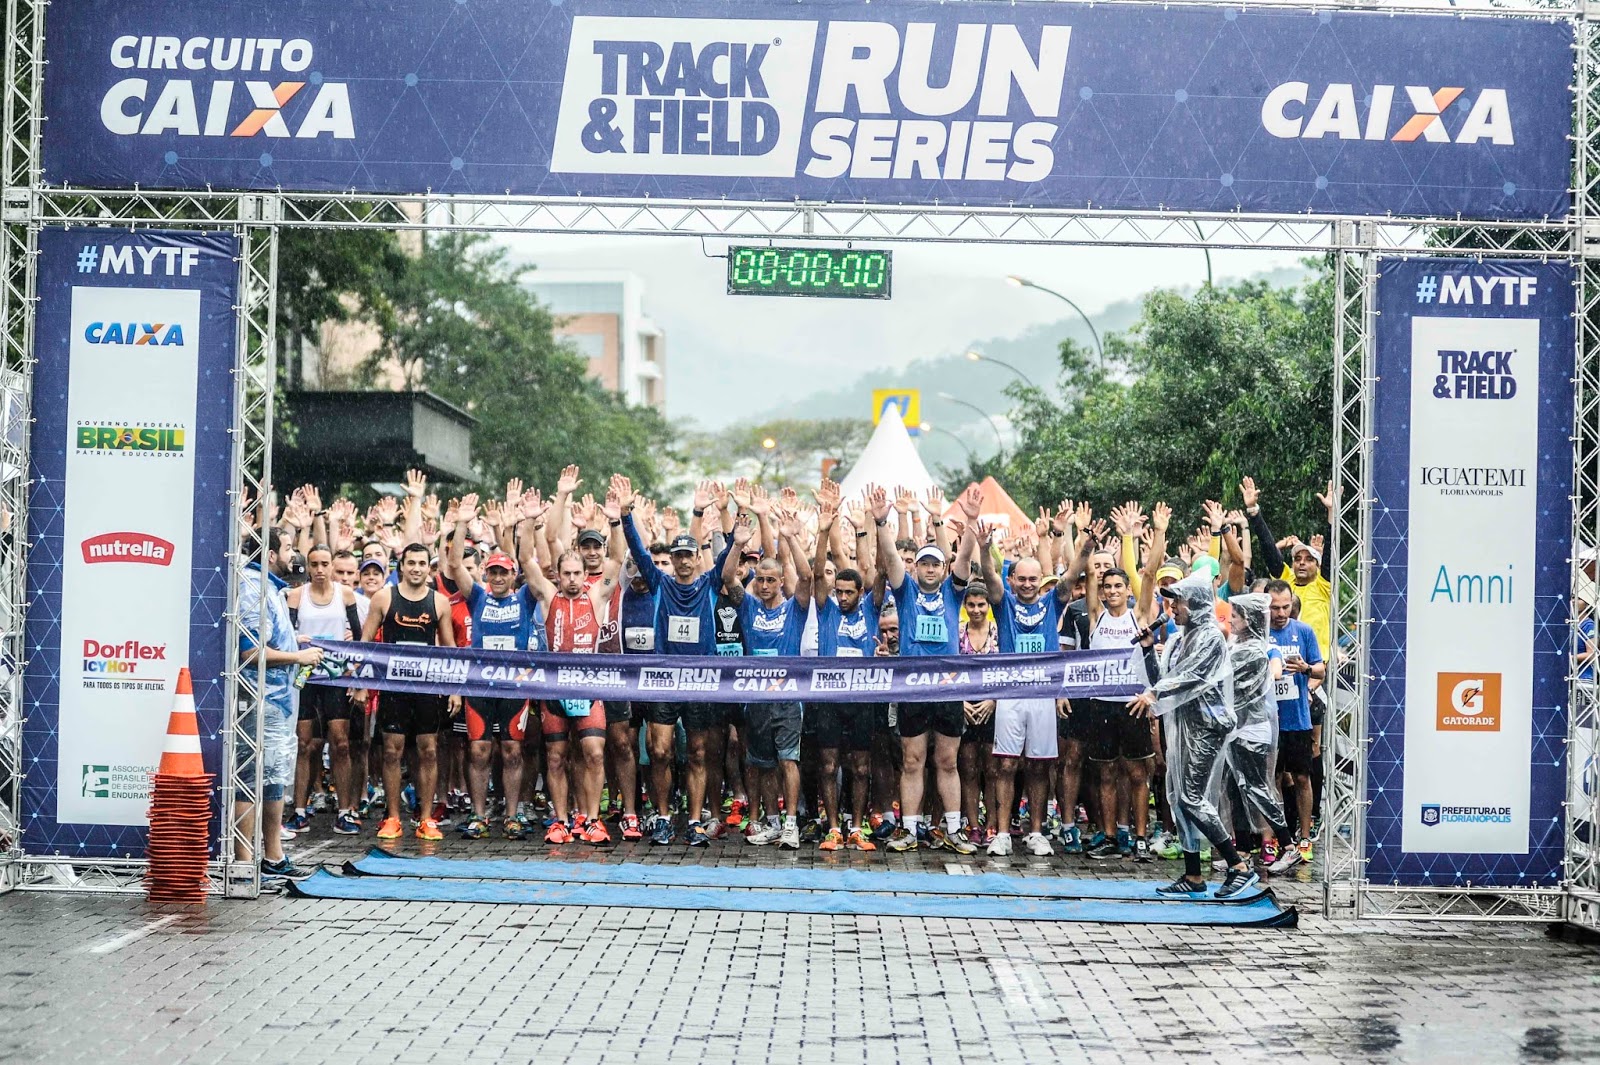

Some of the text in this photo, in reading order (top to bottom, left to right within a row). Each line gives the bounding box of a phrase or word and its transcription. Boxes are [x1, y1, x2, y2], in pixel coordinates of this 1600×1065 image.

[110, 35, 313, 71] CIRCUITO
[592, 40, 773, 98] TRACK
[818, 20, 1072, 118] RUN
[100, 78, 356, 138] CAIXA
[1261, 81, 1514, 145] CAIXA
[580, 98, 782, 156] & FIELD
[804, 118, 1057, 182] SERIES
[77, 245, 199, 276] #MYTF
[733, 250, 885, 288] 00:00:00
[1416, 275, 1537, 306] #MYTF
[85, 322, 184, 346] CAIXA
[1437, 350, 1513, 375] TRACK
[1432, 374, 1517, 400] & FIELD
[77, 427, 184, 451] BRASIL
[1420, 467, 1526, 487] IGUATEMI
[1440, 488, 1504, 496] FLORIANÓPOLIS
[89, 540, 165, 559] nutrella
[1430, 564, 1513, 604] Amni
[678, 624, 690, 636] 44
[921, 622, 942, 636] 1111
[635, 633, 647, 645] 35
[1020, 641, 1042, 652] 1188
[83, 640, 166, 660] Dorflex
[393, 659, 422, 669] TRACK
[428, 658, 470, 674] RUN
[1069, 664, 1098, 674] TRACK
[1104, 659, 1135, 675] RU
[391, 668, 423, 678] & FIELD
[426, 671, 468, 684] SERIES
[481, 666, 546, 682] CAIXA
[557, 669, 627, 685] BRASIL
[644, 670, 673, 680] TRACK
[680, 668, 721, 683] RUN
[735, 668, 788, 678] CIRCUITO
[816, 672, 845, 681] TRACK
[852, 668, 894, 683] RUN
[905, 672, 971, 686] CAIXA
[982, 669, 1052, 684] BRASIL
[1067, 673, 1100, 683] & FIELD
[83, 681, 166, 692] PARA TODOS OS TIPOS DE ATLETAS.
[642, 679, 675, 688] & FIELD
[679, 682, 720, 691] SERIES
[732, 678, 798, 692] CAIXA
[815, 681, 847, 689] & FIELD
[850, 682, 892, 691] SERIES
[1451, 679, 1485, 716] G
[1442, 716, 1495, 726] GATORADE
[111, 783, 122, 791] DE
[1441, 806, 1511, 815] PREFEITURA DE
